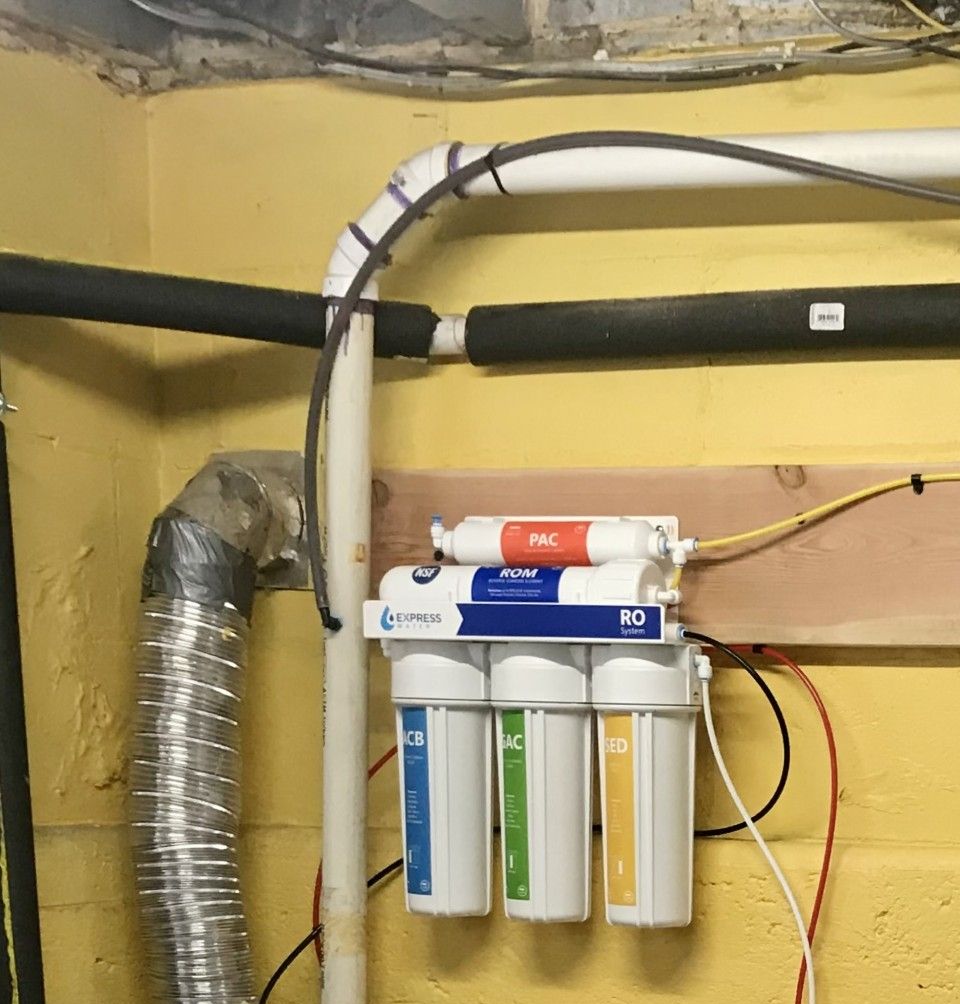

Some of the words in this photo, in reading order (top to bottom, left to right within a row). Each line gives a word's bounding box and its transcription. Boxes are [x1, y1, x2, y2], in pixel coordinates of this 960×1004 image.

[529, 532, 559, 547] PAC
[414, 567, 438, 578] NSF
[500, 568, 538, 578] ROM
[396, 613, 442, 623] EXPRESS
[620, 609, 646, 626] RO
[620, 627, 646, 636] System
